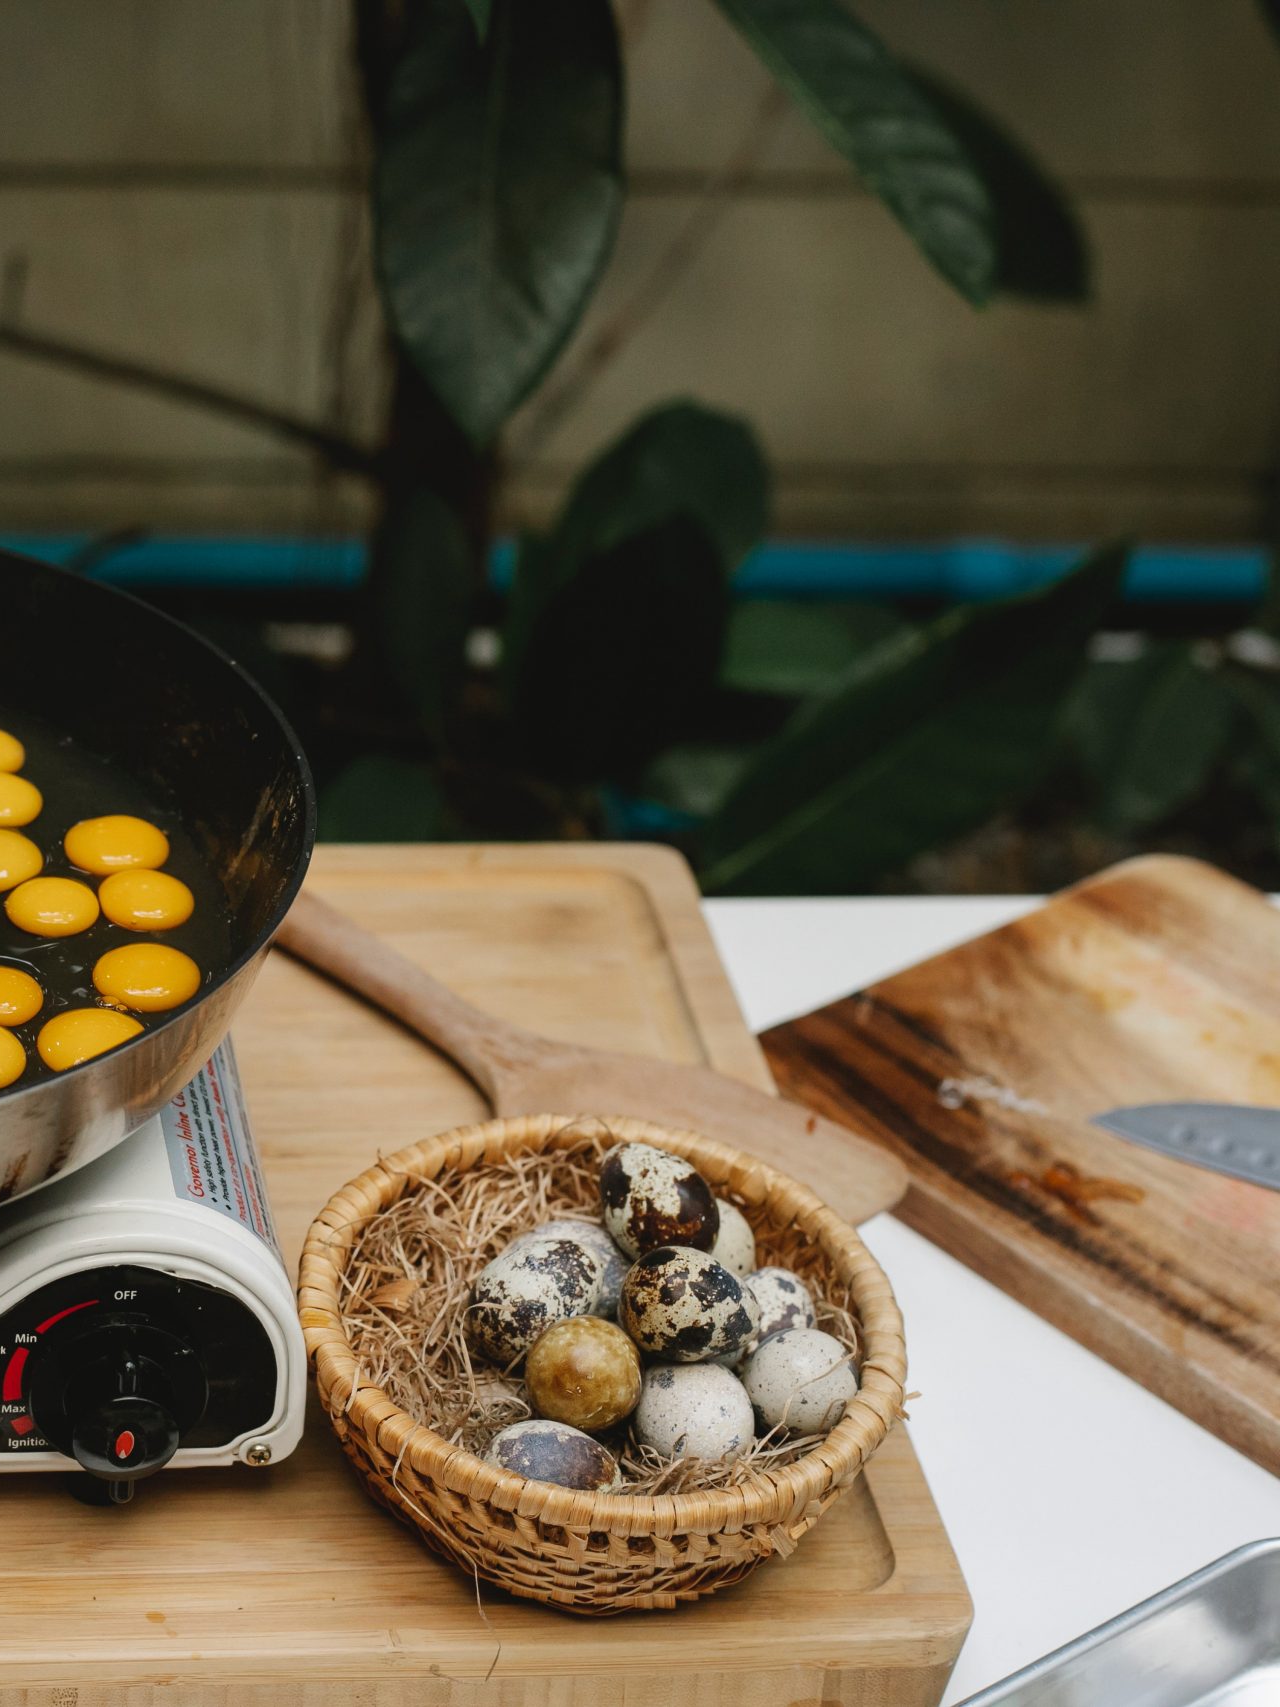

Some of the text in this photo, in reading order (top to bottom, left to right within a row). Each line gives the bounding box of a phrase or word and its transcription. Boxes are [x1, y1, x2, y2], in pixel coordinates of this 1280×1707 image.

[175, 1111, 193, 1142] Inline
[187, 1144, 205, 1197] Governor
[113, 1290, 138, 1300] OFF
[14, 1333, 38, 1343] Min
[1, 1404, 26, 1413] Max
[8, 1437, 49, 1448] Ignitio
